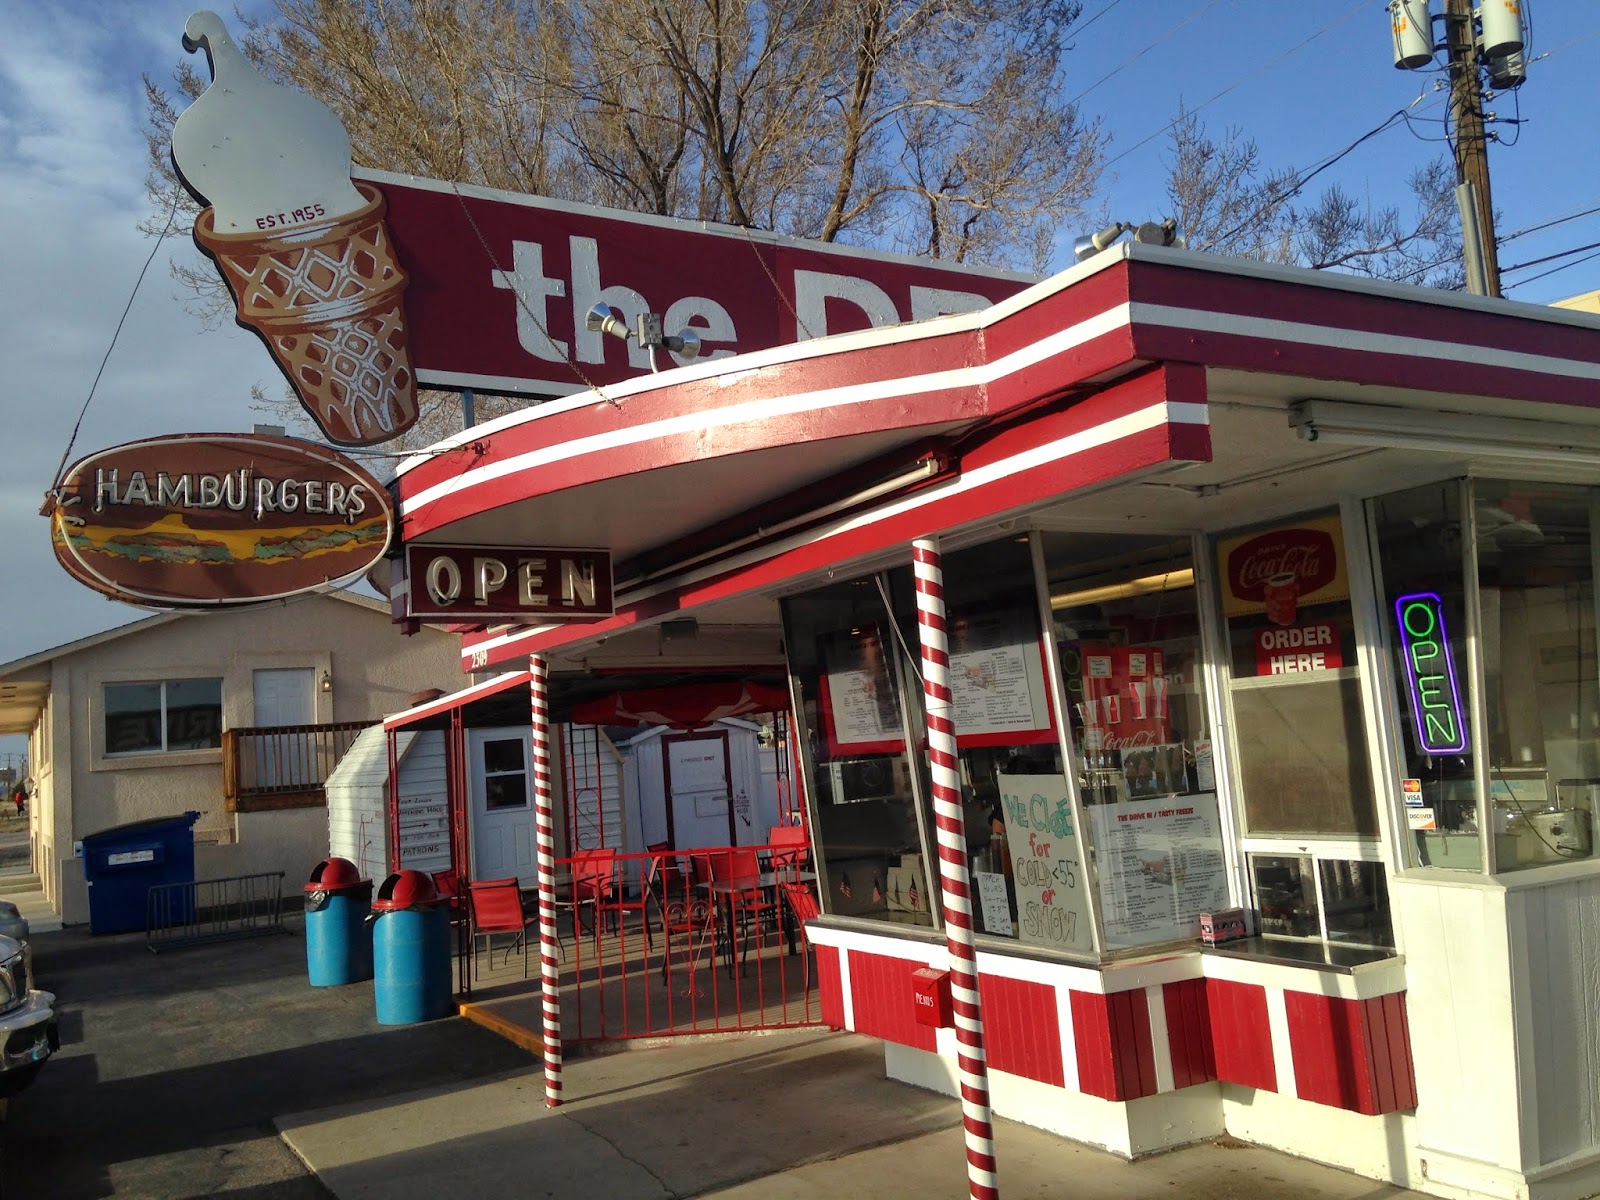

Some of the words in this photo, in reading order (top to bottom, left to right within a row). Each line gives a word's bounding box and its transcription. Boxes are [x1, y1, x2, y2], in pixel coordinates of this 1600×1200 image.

[492, 235, 737, 368] the
[94, 467, 367, 518] HAMBURGERS
[426, 556, 596, 607] OPEN
[1261, 625, 1332, 650] ORDER
[1270, 652, 1326, 675] HERE
[1404, 603, 1456, 743] OPEN
[402, 845, 440, 856] PATRONS
[1029, 832, 1050, 857] for
[1016, 857, 1053, 888] COLD
[1041, 889, 1057, 905] or
[1023, 900, 1077, 943] SNOW
